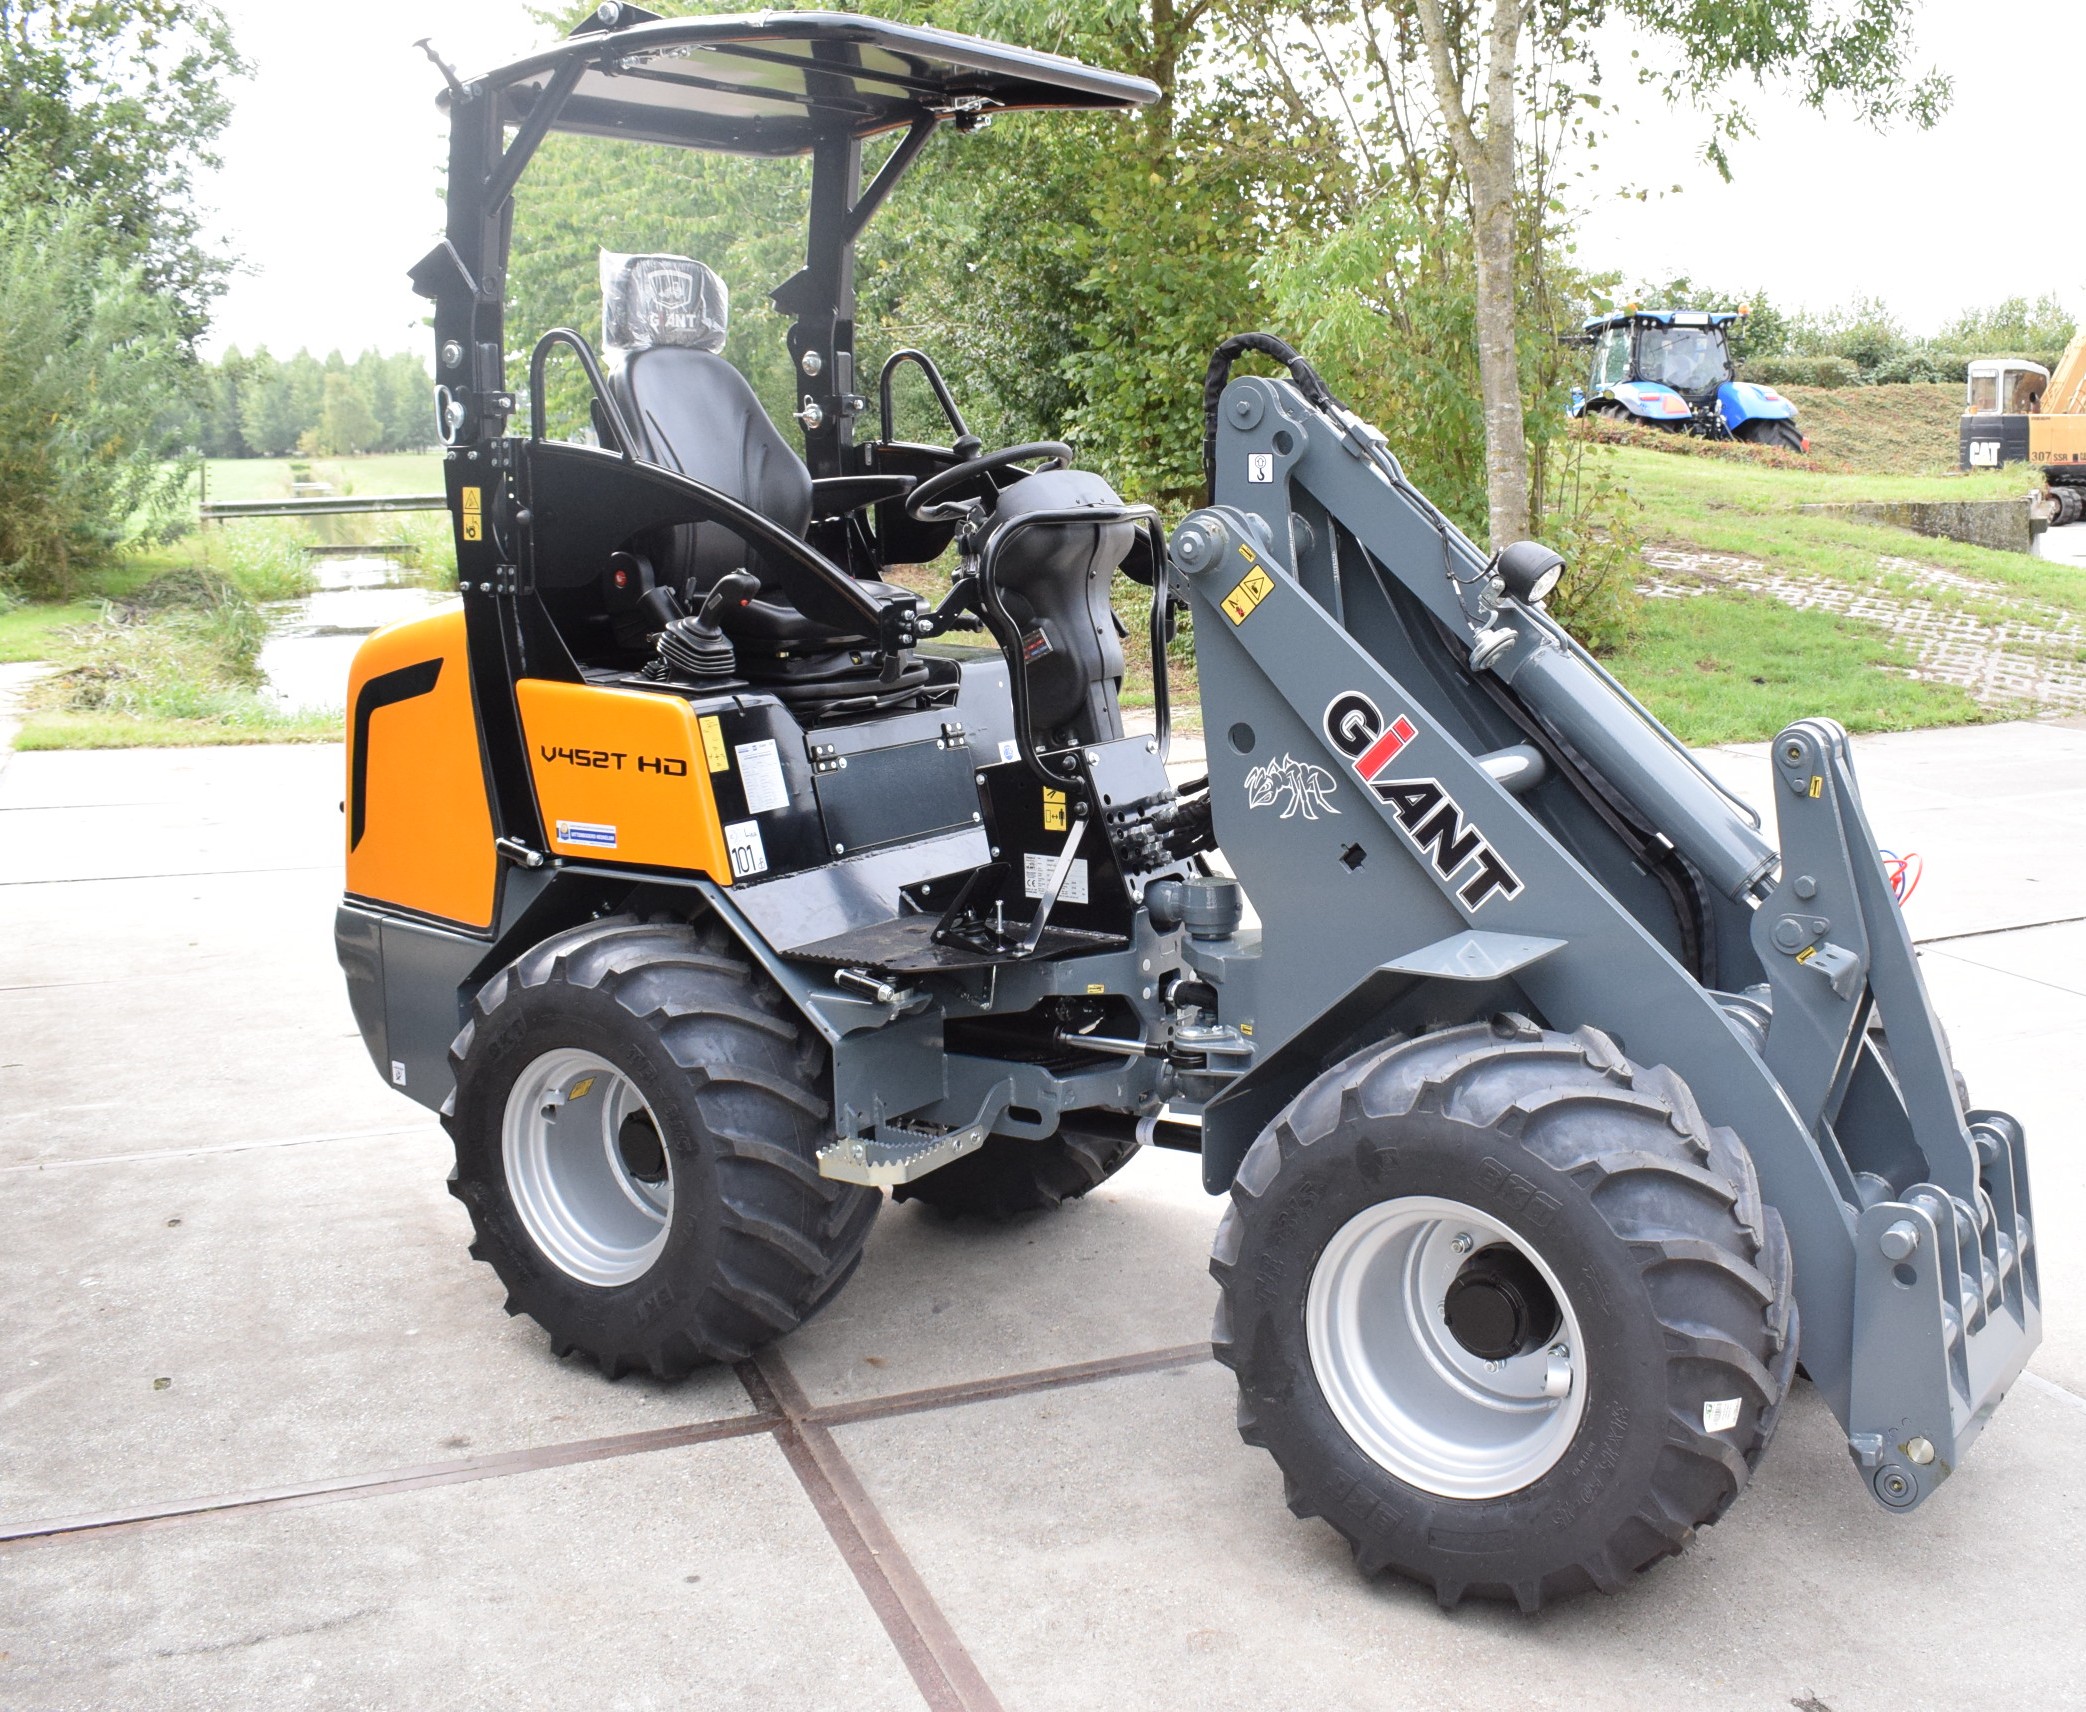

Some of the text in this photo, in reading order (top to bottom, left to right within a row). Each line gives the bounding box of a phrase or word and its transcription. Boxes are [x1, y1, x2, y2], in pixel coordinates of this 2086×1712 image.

[649, 312, 697, 329] GIANT
[1969, 441, 2001, 466] CAT
[2031, 451, 2052, 462] 307
[541, 745, 687, 777] V452T HD
[1323, 690, 1525, 913] GIANT
[731, 844, 757, 875] 101
[1026, 879, 1036, 888] CE
